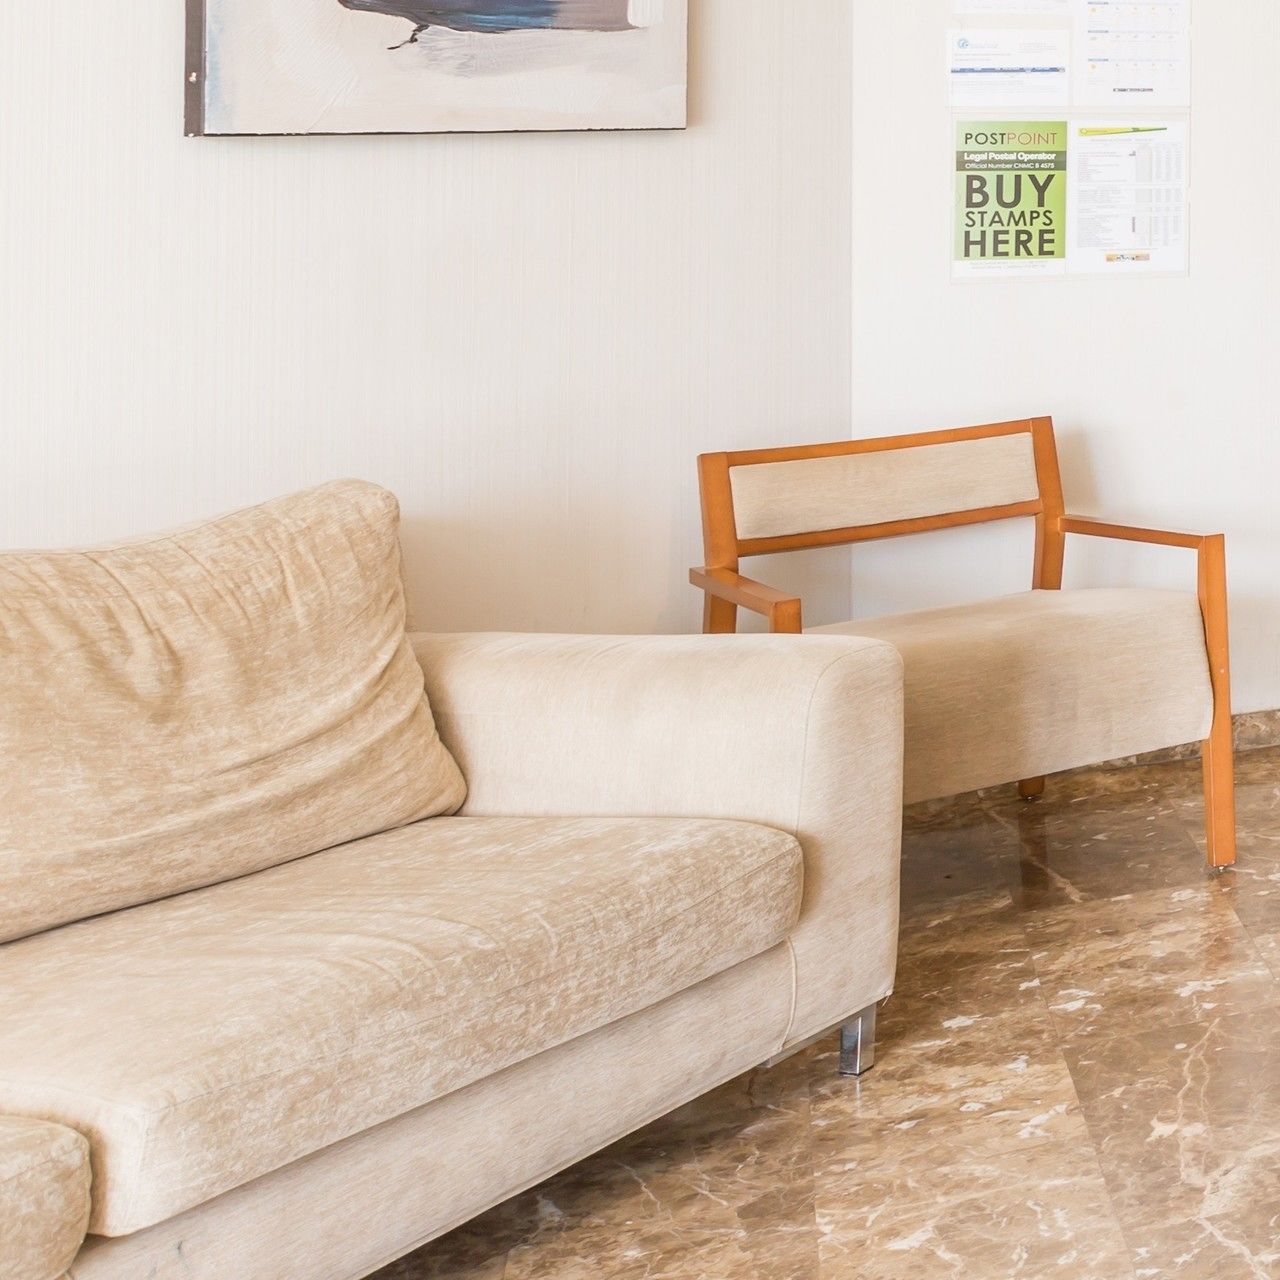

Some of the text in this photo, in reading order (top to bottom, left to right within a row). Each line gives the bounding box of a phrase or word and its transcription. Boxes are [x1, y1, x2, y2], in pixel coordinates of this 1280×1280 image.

[965, 132, 1057, 145] POSTPOINT
[964, 152, 1057, 162] Legal Postal Operator
[966, 174, 1056, 209] BUY
[965, 210, 1053, 227] STAMPS
[964, 228, 1055, 258] HERE
